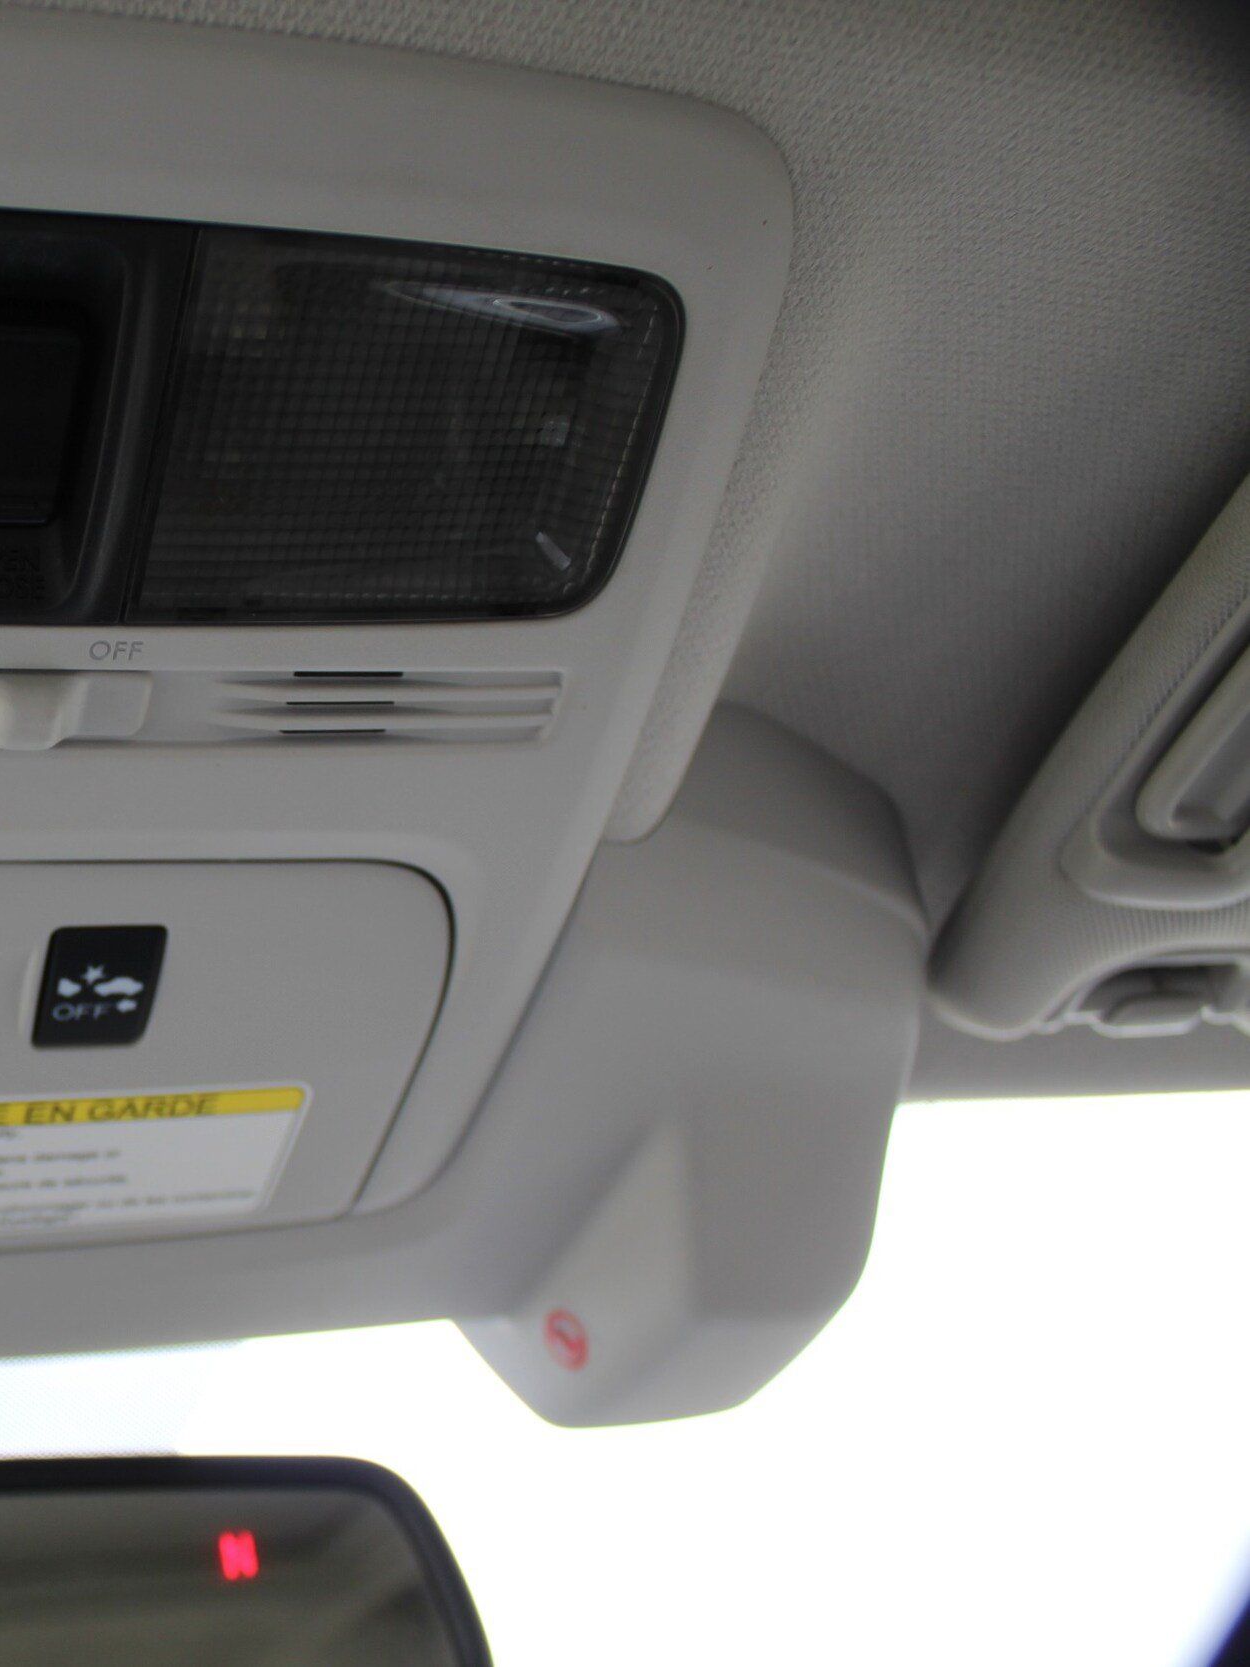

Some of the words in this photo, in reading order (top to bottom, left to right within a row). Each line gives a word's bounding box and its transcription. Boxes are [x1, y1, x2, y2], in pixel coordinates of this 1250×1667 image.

[88, 639, 144, 661] OFF
[52, 1002, 111, 1022] OFF
[23, 1100, 76, 1125] EN
[87, 1093, 221, 1121] GARDE
